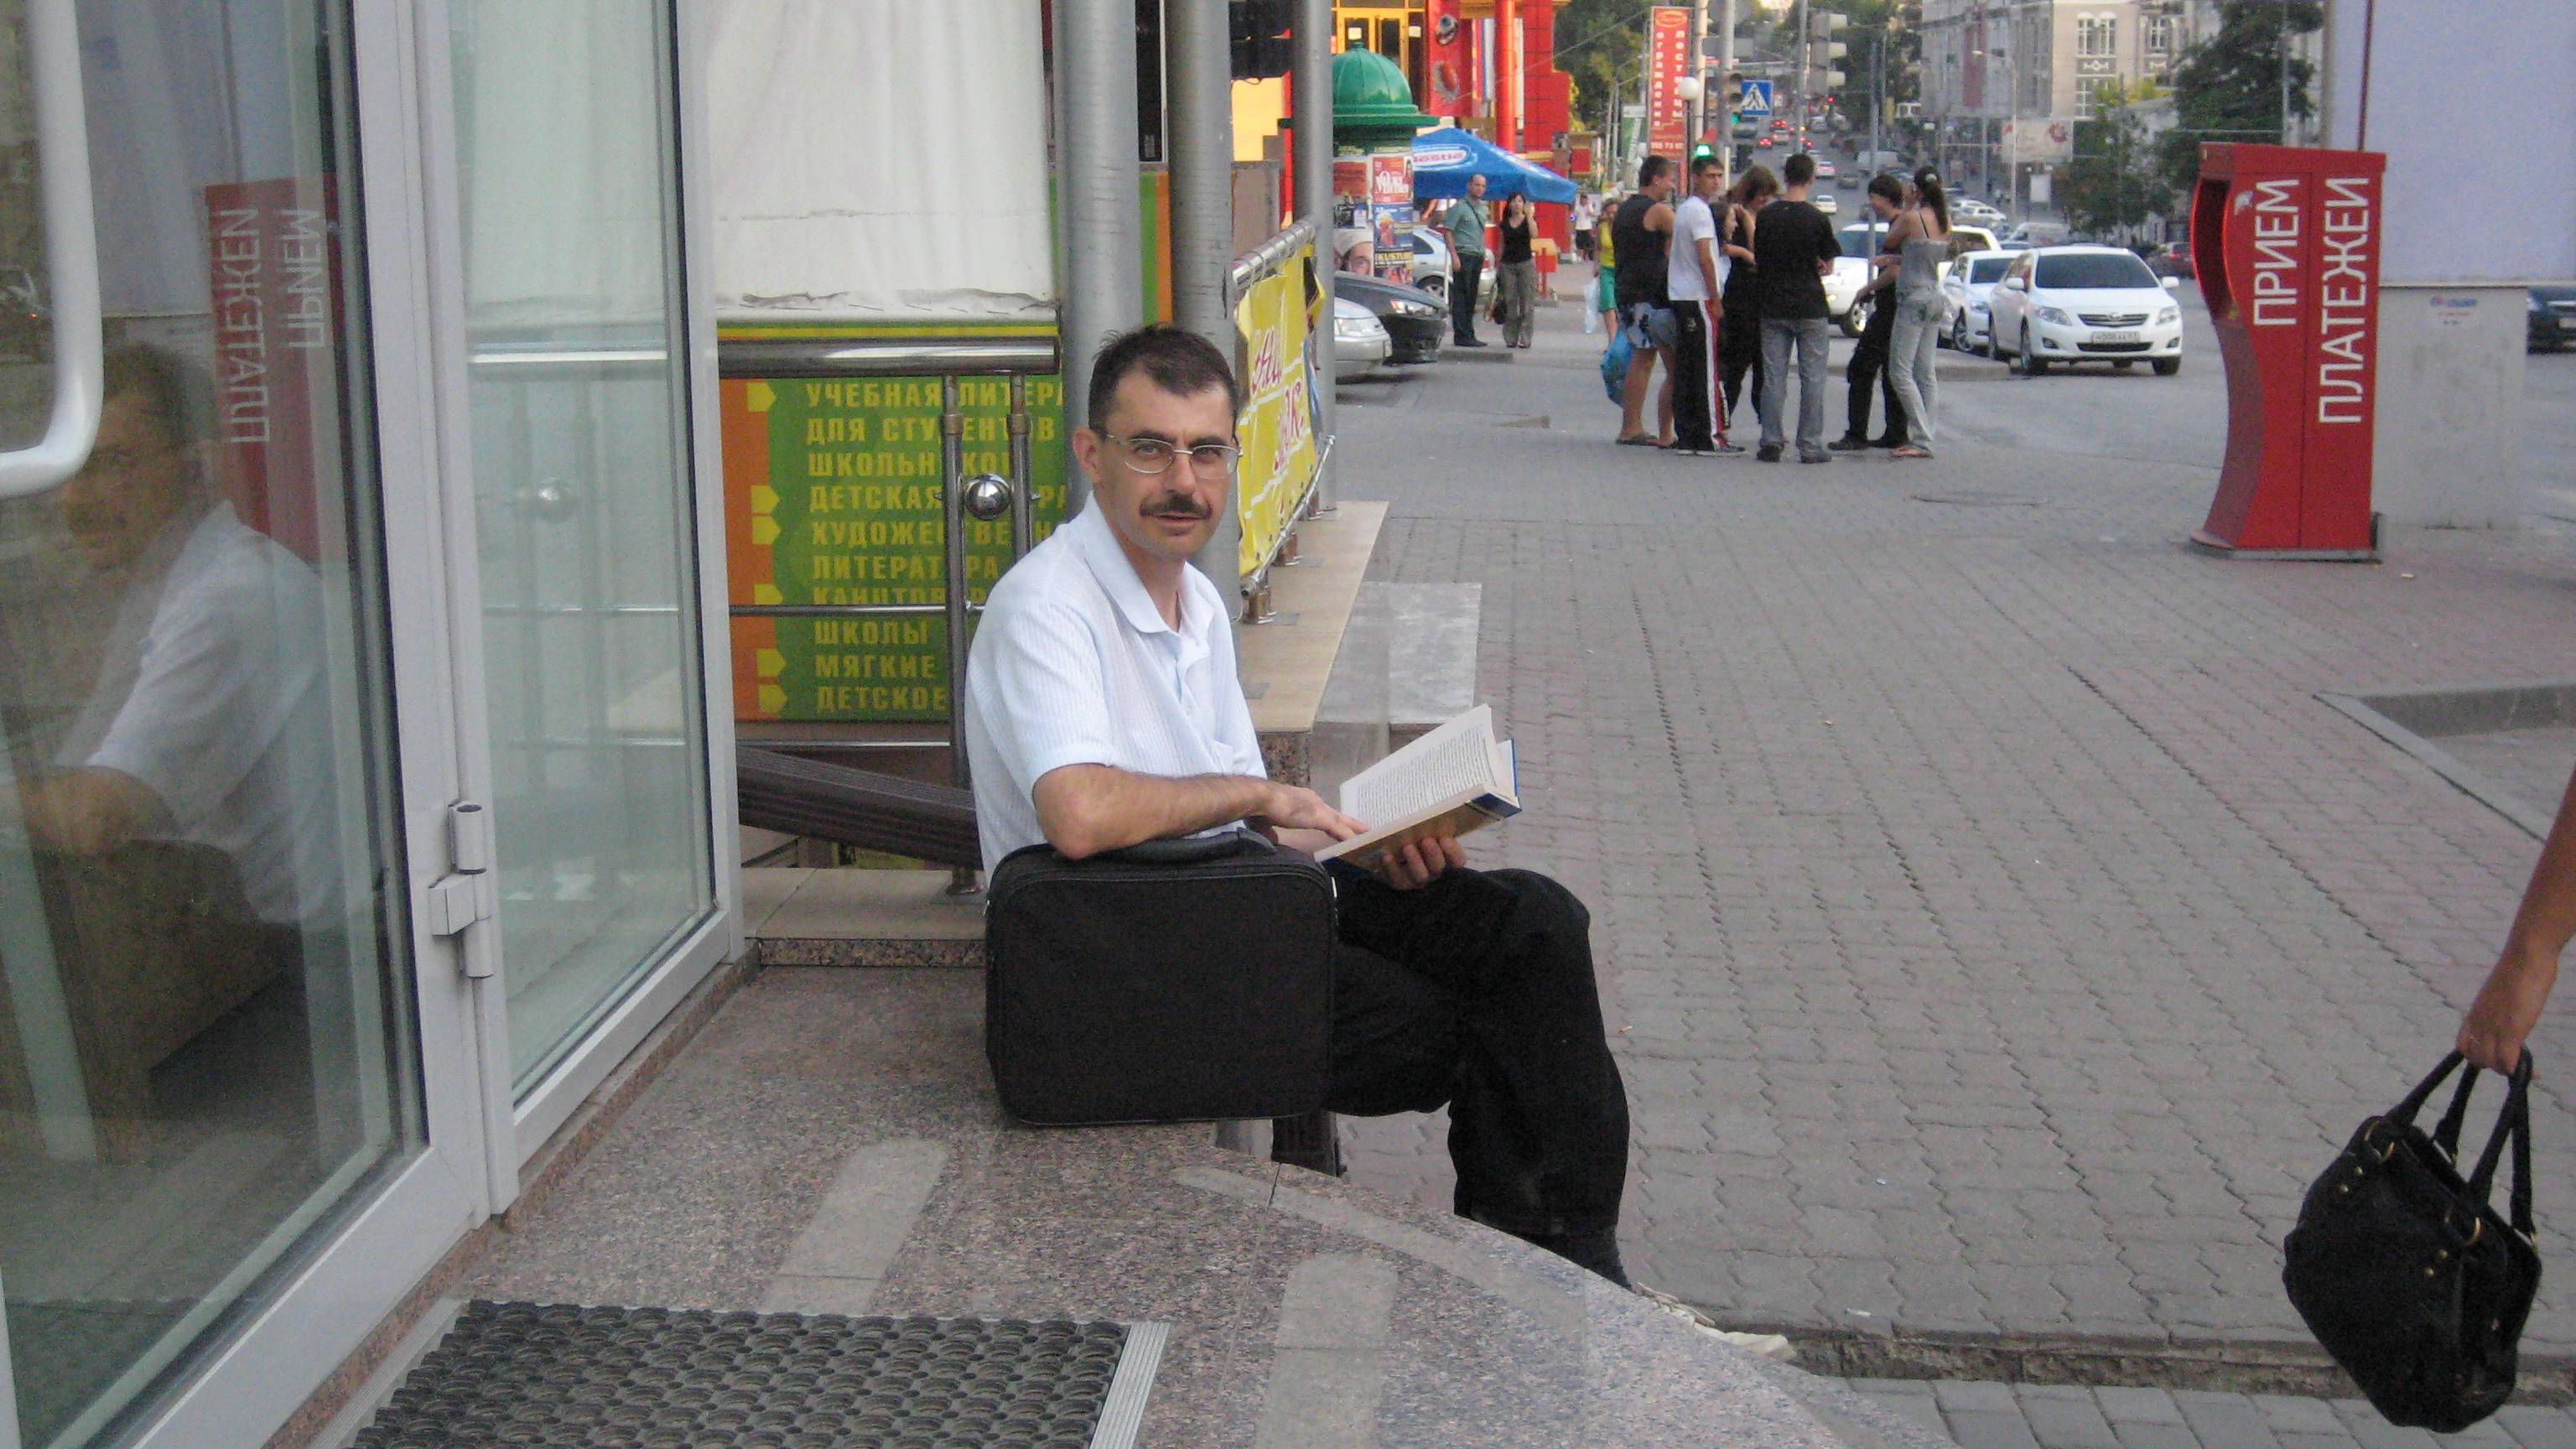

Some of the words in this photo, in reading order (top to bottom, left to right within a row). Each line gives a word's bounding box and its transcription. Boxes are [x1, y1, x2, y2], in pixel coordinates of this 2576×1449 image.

[2252, 179, 2300, 326] ПРИЕМ
[806, 382, 942, 408] УЧЕБНАЯ
[806, 418, 865, 445] ДЛЯ
[810, 486, 943, 513] ДЕТСКАЯ
[813, 555, 999, 579] ЛИТЕРАТРА
[814, 621, 930, 645] ШКОЛЫ
[815, 654, 937, 678] МЯГКИЕ
[817, 686, 948, 713] ДЕТСКОЕ
